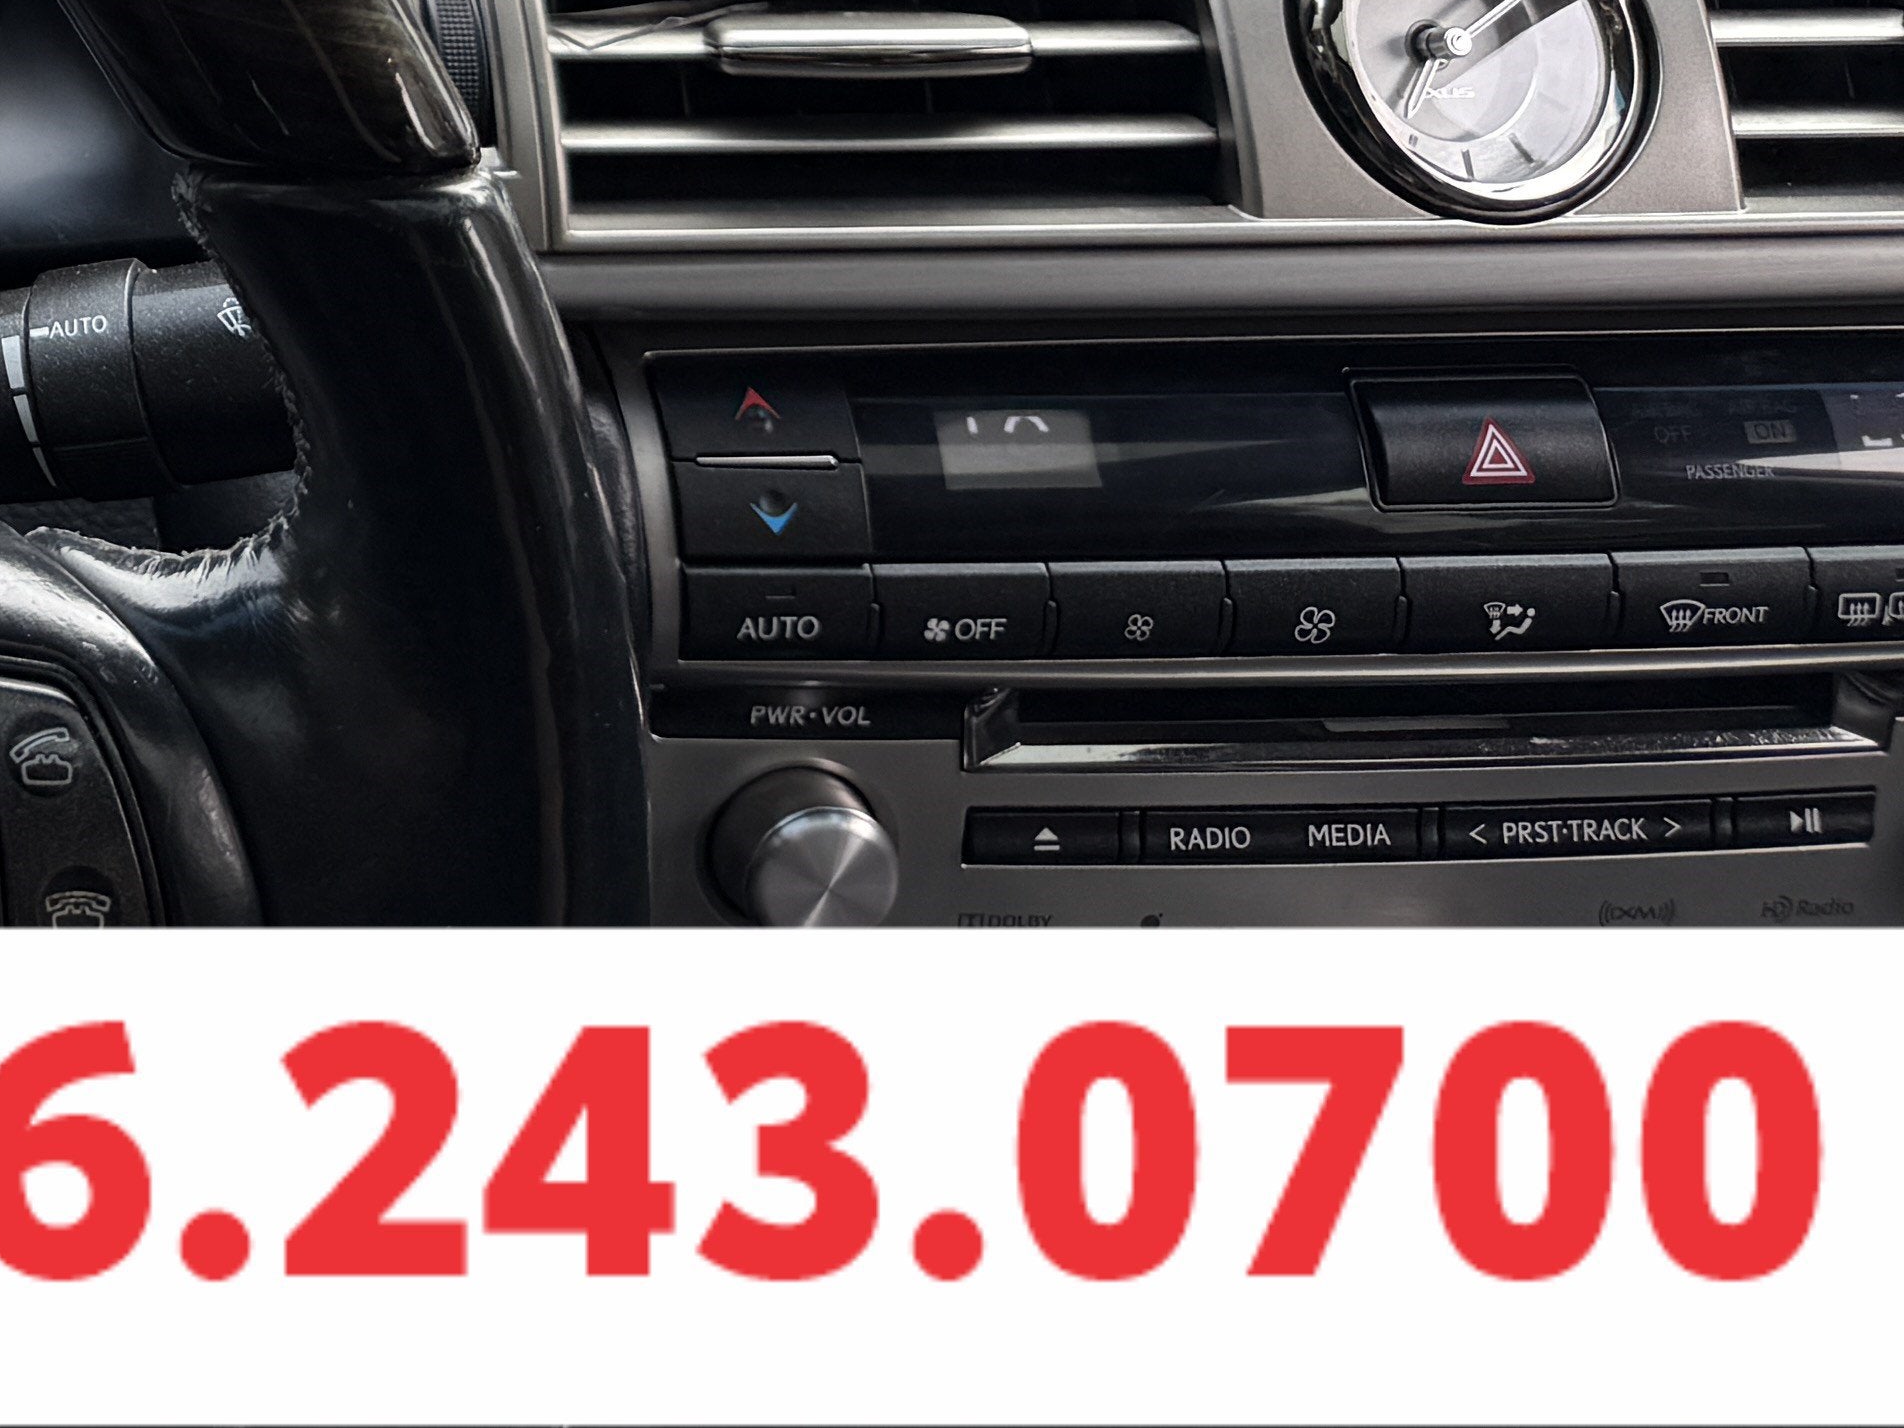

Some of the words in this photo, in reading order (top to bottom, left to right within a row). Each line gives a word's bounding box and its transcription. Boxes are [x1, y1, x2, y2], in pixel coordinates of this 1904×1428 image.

[49, 315, 109, 339] AUTO
[1753, 423, 1786, 440] ON
[1686, 464, 1775, 479] PASSENGER
[1703, 604, 1770, 626] FRONT
[737, 615, 821, 641] AUTO
[955, 618, 1008, 641] OFF
[1169, 826, 1251, 851] RADIO
[1307, 823, 1392, 847] MEDIA
